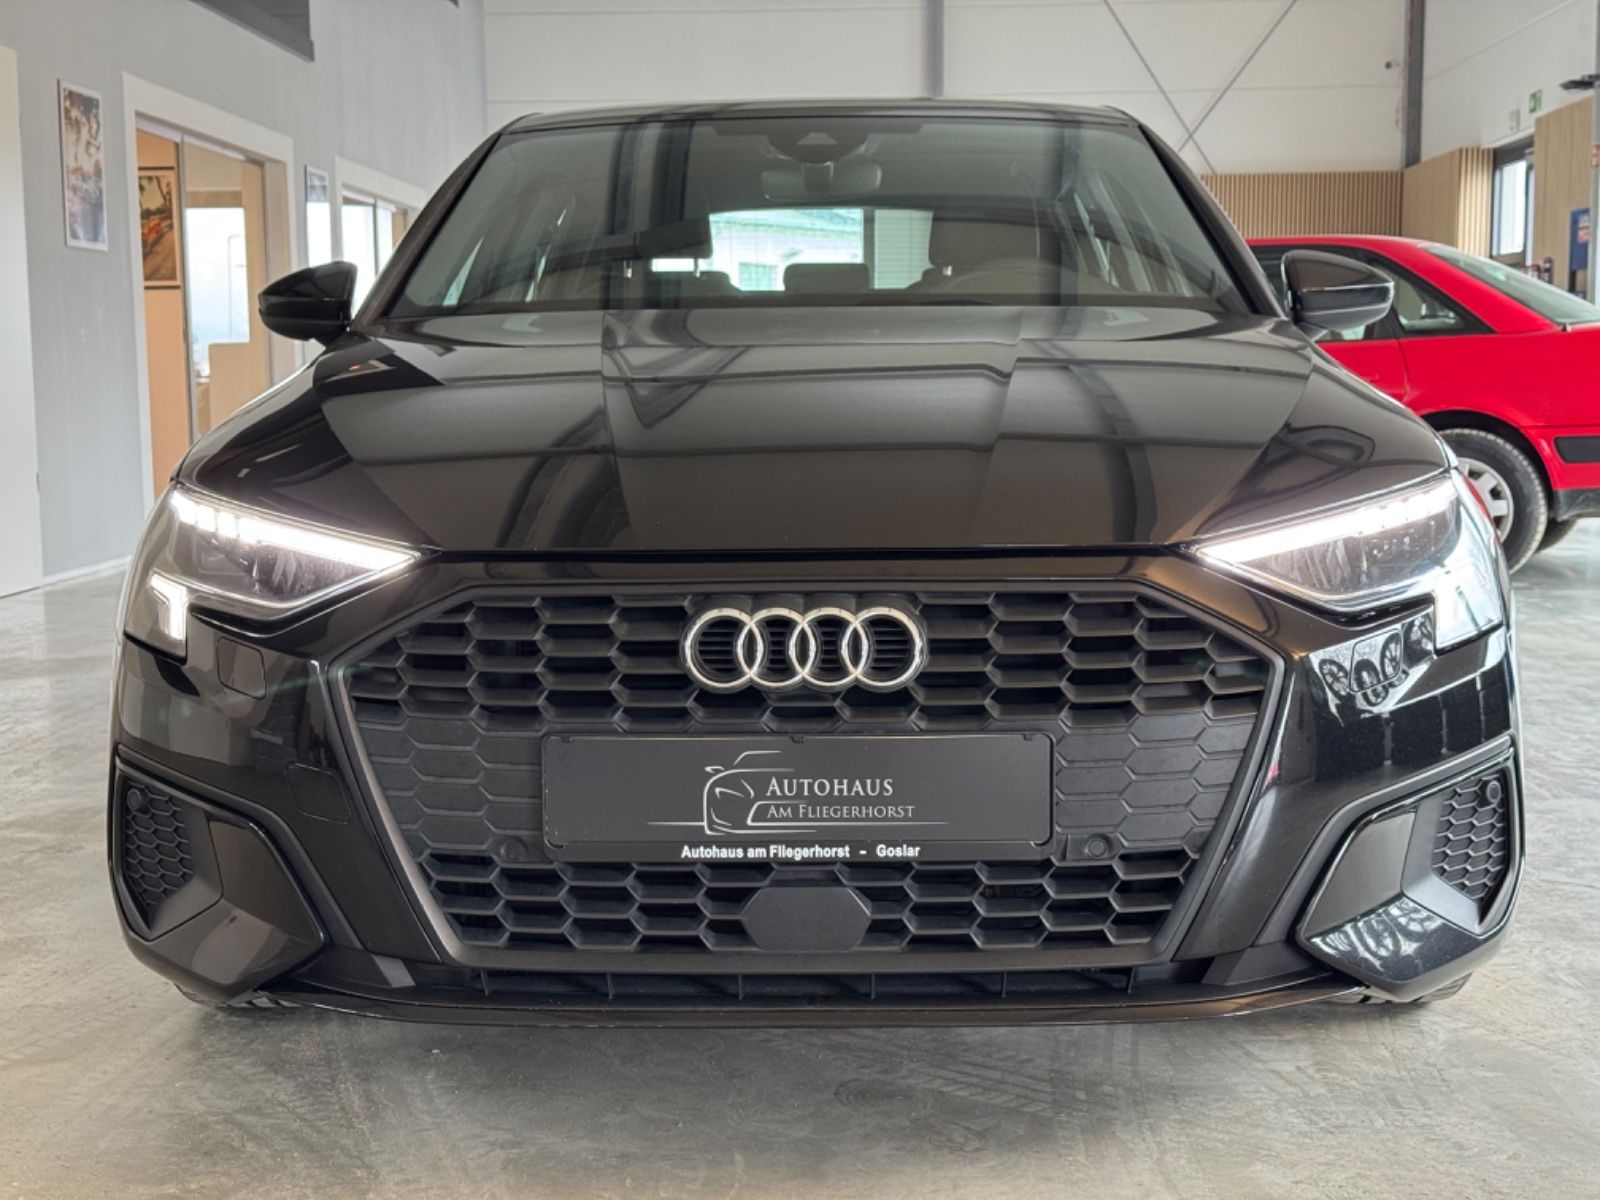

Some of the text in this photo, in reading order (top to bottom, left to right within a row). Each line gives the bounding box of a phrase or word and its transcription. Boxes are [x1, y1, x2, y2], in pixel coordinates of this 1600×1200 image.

[765, 776, 893, 797] AUTOHAUS
[766, 803, 916, 818] AM FLIEGERHORST
[680, 844, 744, 859] Autohaus
[746, 847, 767, 859] am
[769, 843, 851, 861] Fliegerhorst
[875, 843, 922, 859] Goslar
